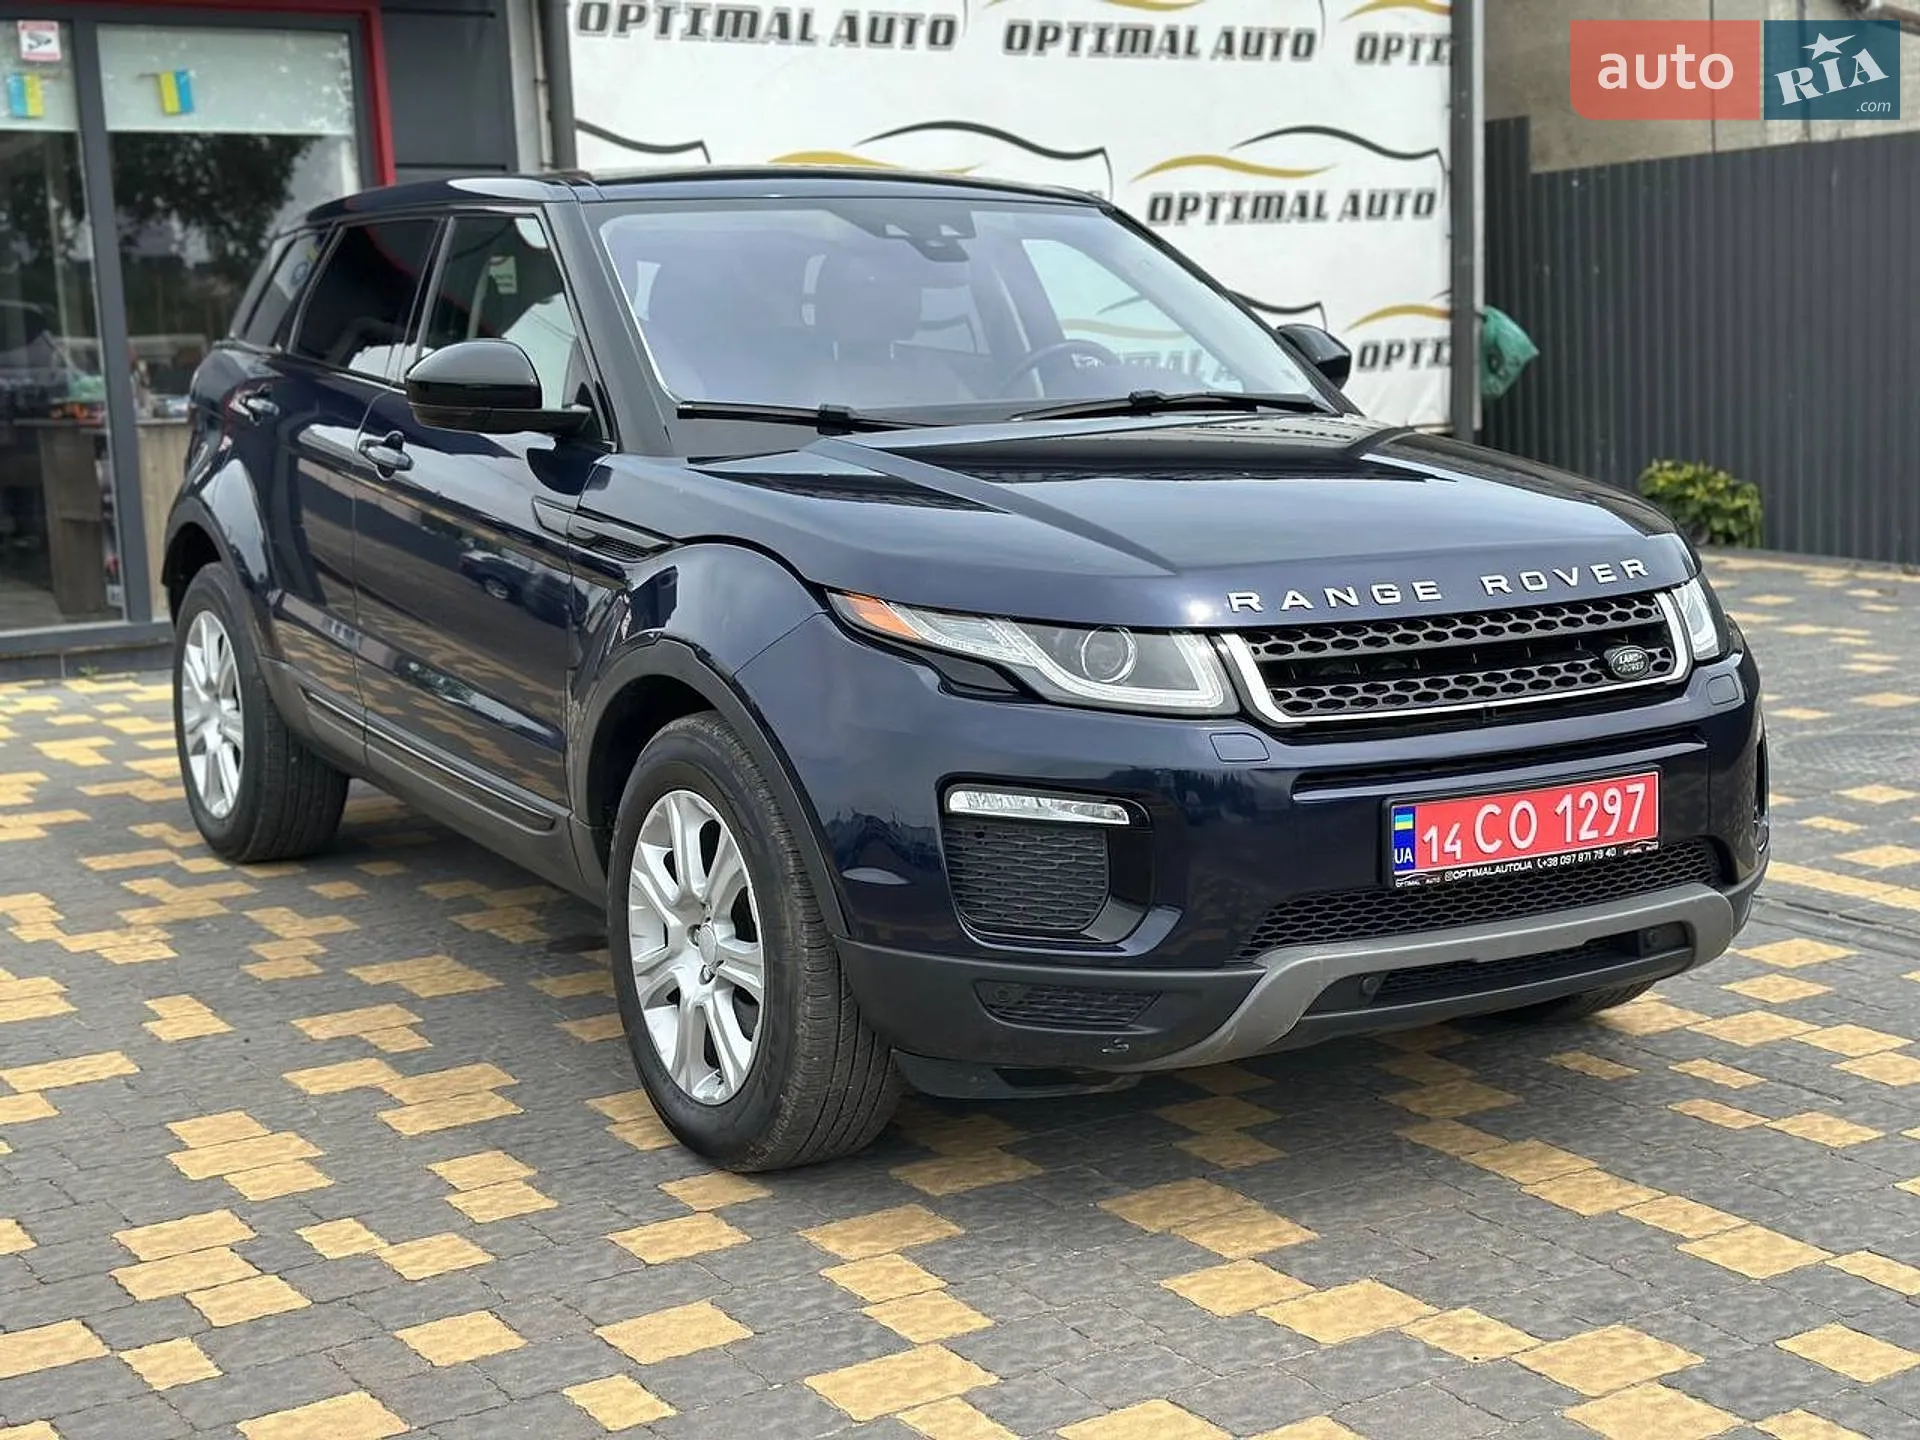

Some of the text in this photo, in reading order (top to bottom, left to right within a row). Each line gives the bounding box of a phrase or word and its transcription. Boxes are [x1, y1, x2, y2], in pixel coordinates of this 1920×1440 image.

[576, 0, 960, 51] OPTIMAL AUTO
[1003, 19, 1317, 63] OPTIMAL AUTO
[1147, 187, 1437, 226] OPTIMAL AUTO
[1227, 558, 1650, 613] RANGE ROVER
[1422, 782, 1646, 863] 14 CO 1297
[1394, 847, 1413, 864] UA
